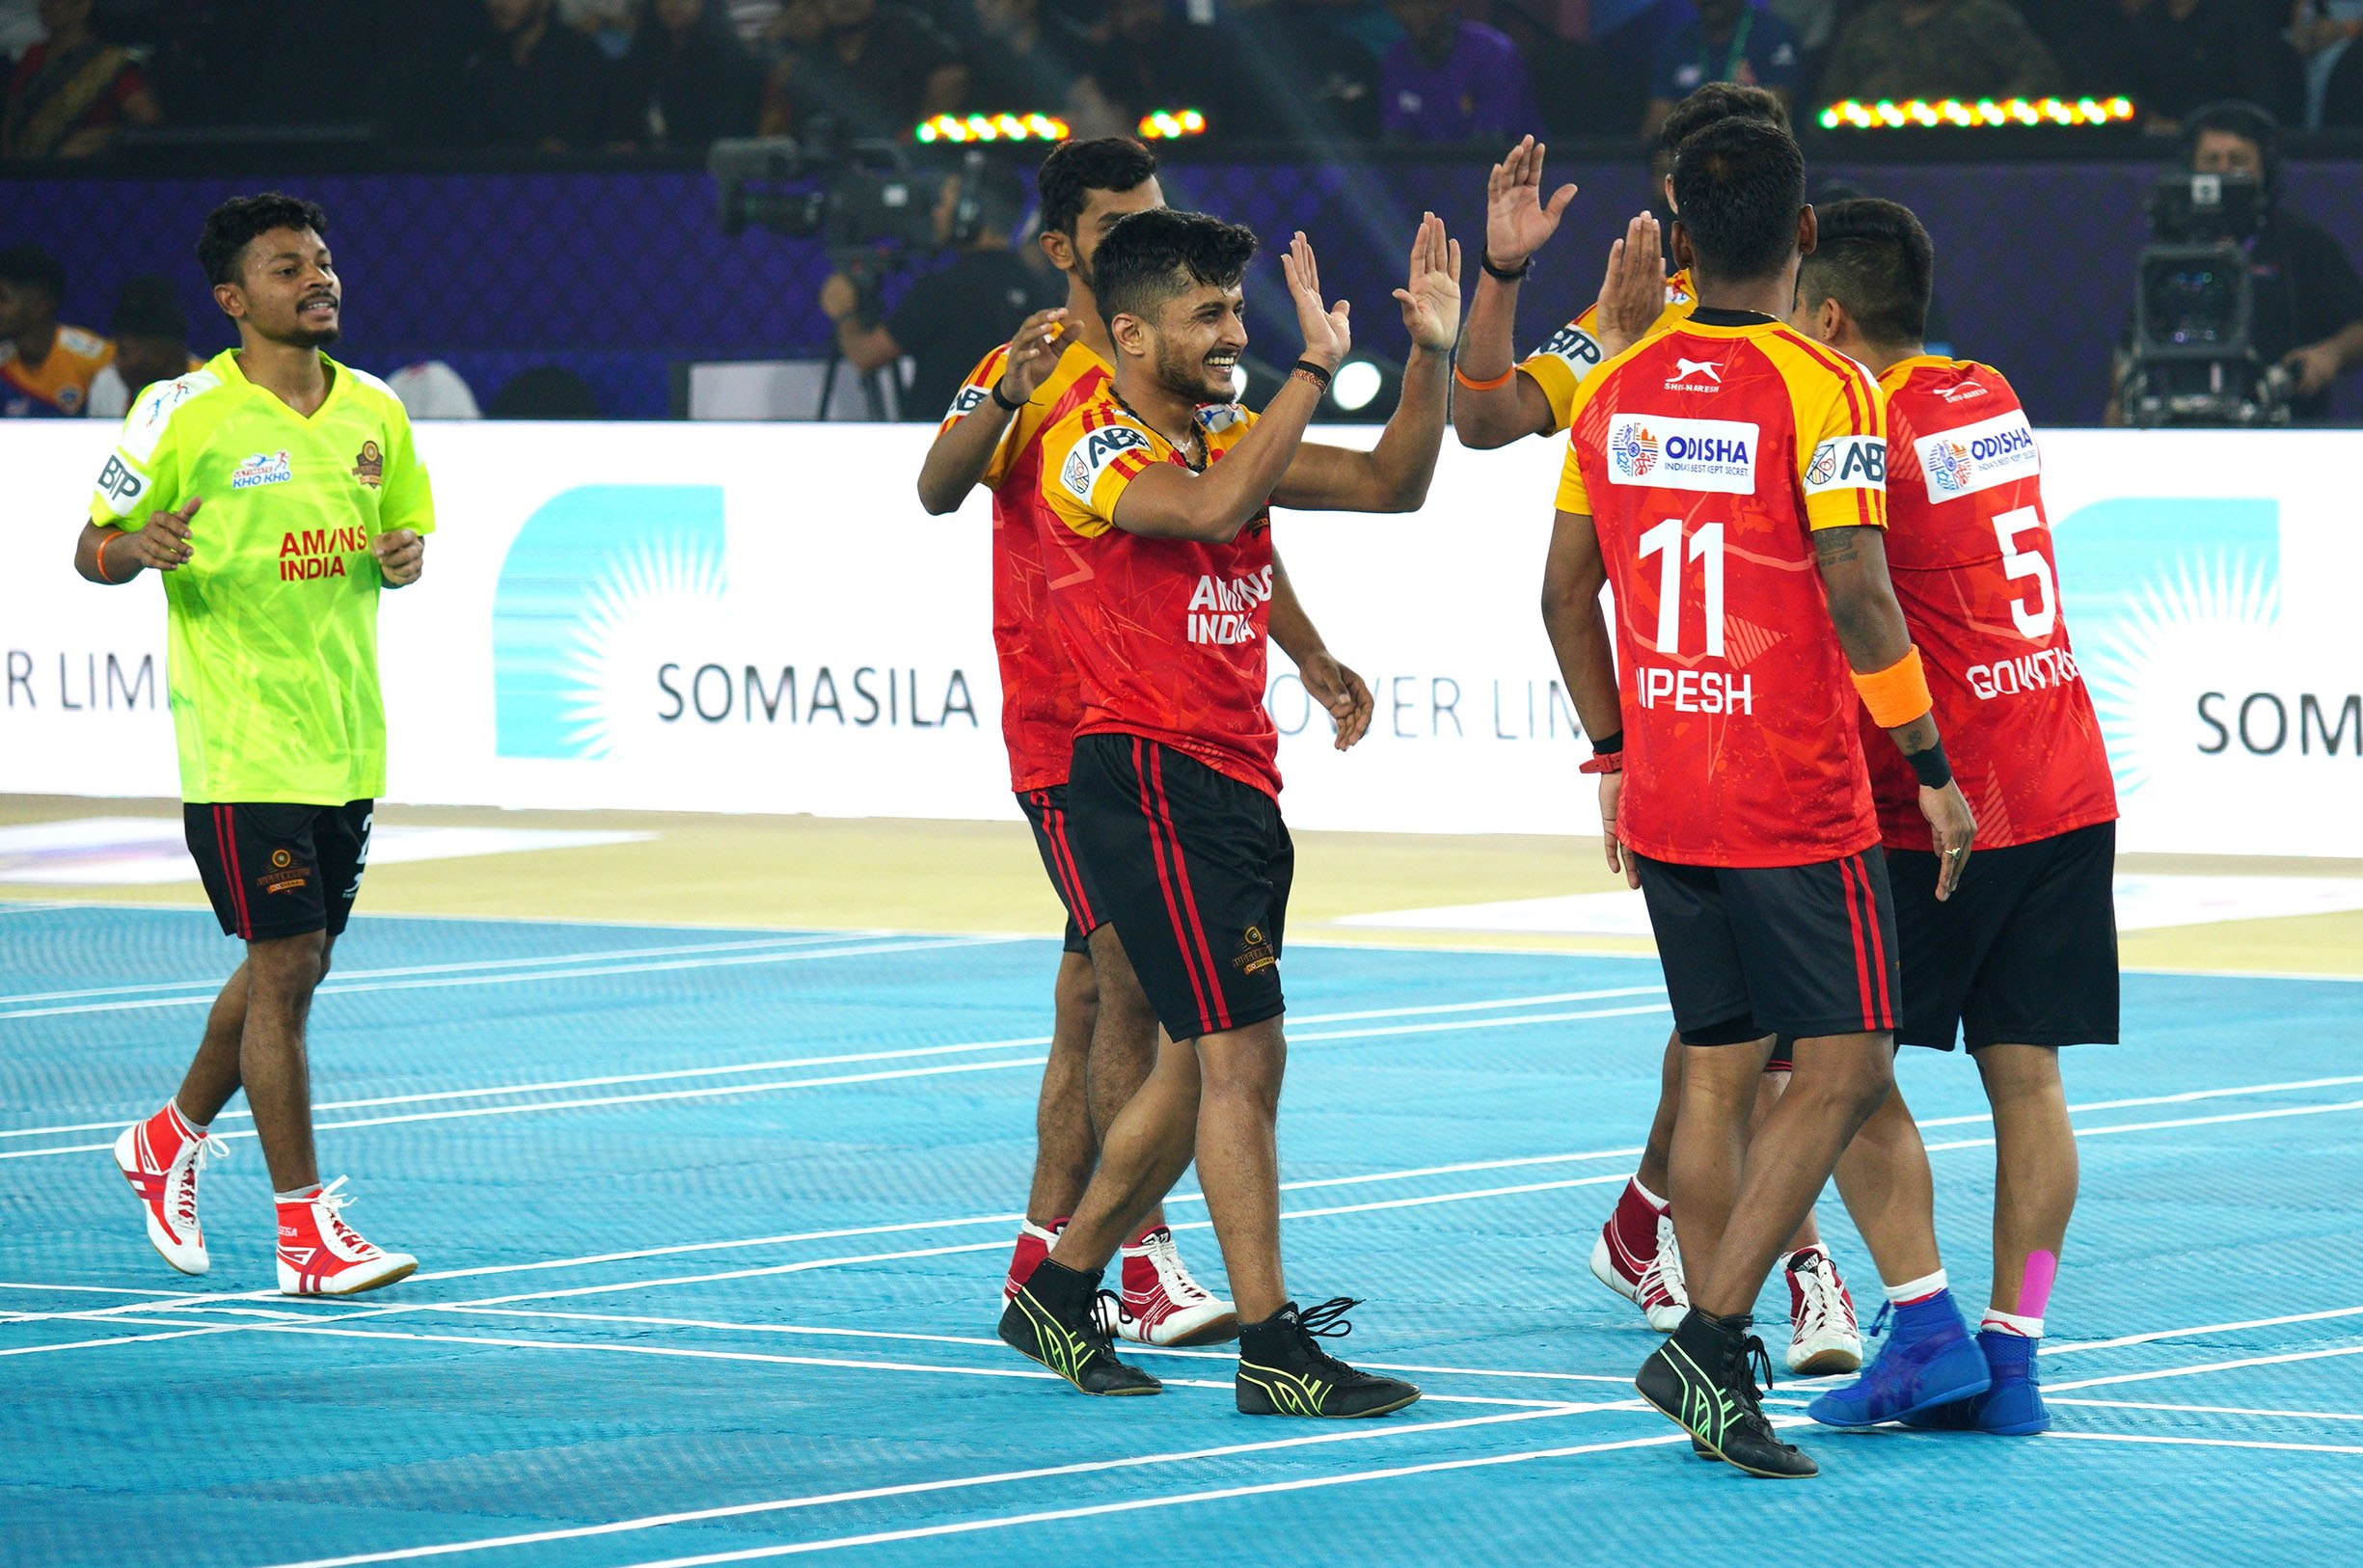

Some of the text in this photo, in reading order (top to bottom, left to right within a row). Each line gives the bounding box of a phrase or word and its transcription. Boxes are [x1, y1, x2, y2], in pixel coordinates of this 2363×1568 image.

[1665, 436, 1749, 465] ODISHA
[1971, 427, 2033, 461] ODISHA
[232, 471, 291, 489] KHO KHO
[280, 525, 367, 558] AM/NS
[280, 556, 346, 581] INDIA
[1639, 518, 1725, 658] 11
[1992, 504, 2056, 639] 5
[1187, 612, 1256, 645] INDIA
[7, 649, 37, 708] R
[658, 662, 979, 729] SOMASILA
[1636, 666, 1752, 716] IPESH
[1268, 673, 1464, 737] OER
[2197, 690, 2363, 757] SOM
